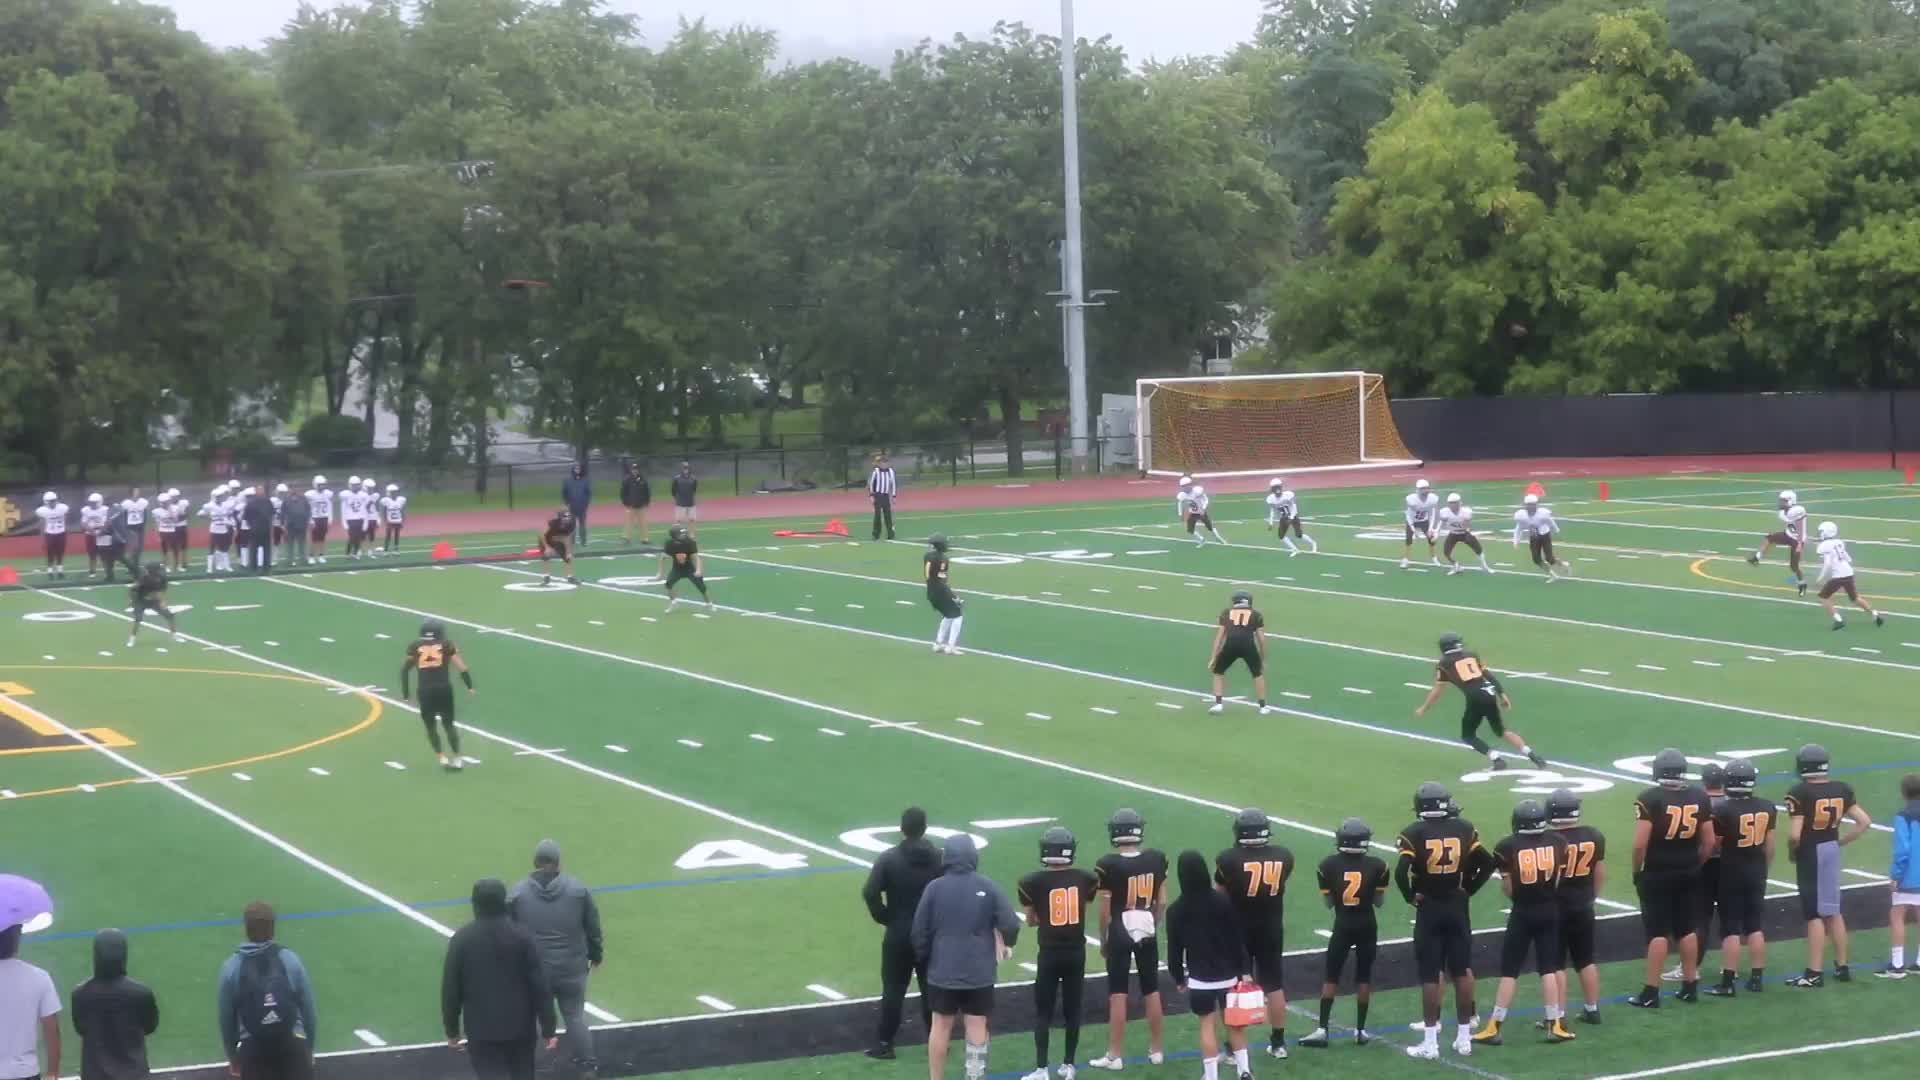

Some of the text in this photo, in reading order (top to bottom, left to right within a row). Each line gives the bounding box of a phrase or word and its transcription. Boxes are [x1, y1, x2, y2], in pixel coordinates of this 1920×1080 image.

[1664, 804, 1699, 839] 75
[1425, 837, 1462, 875] 23
[1518, 846, 1555, 885] 84
[1126, 873, 1155, 910] 14
[1243, 861, 1284, 897] 74
[1342, 872, 1363, 906] 2
[1049, 886, 1080, 927] 81
